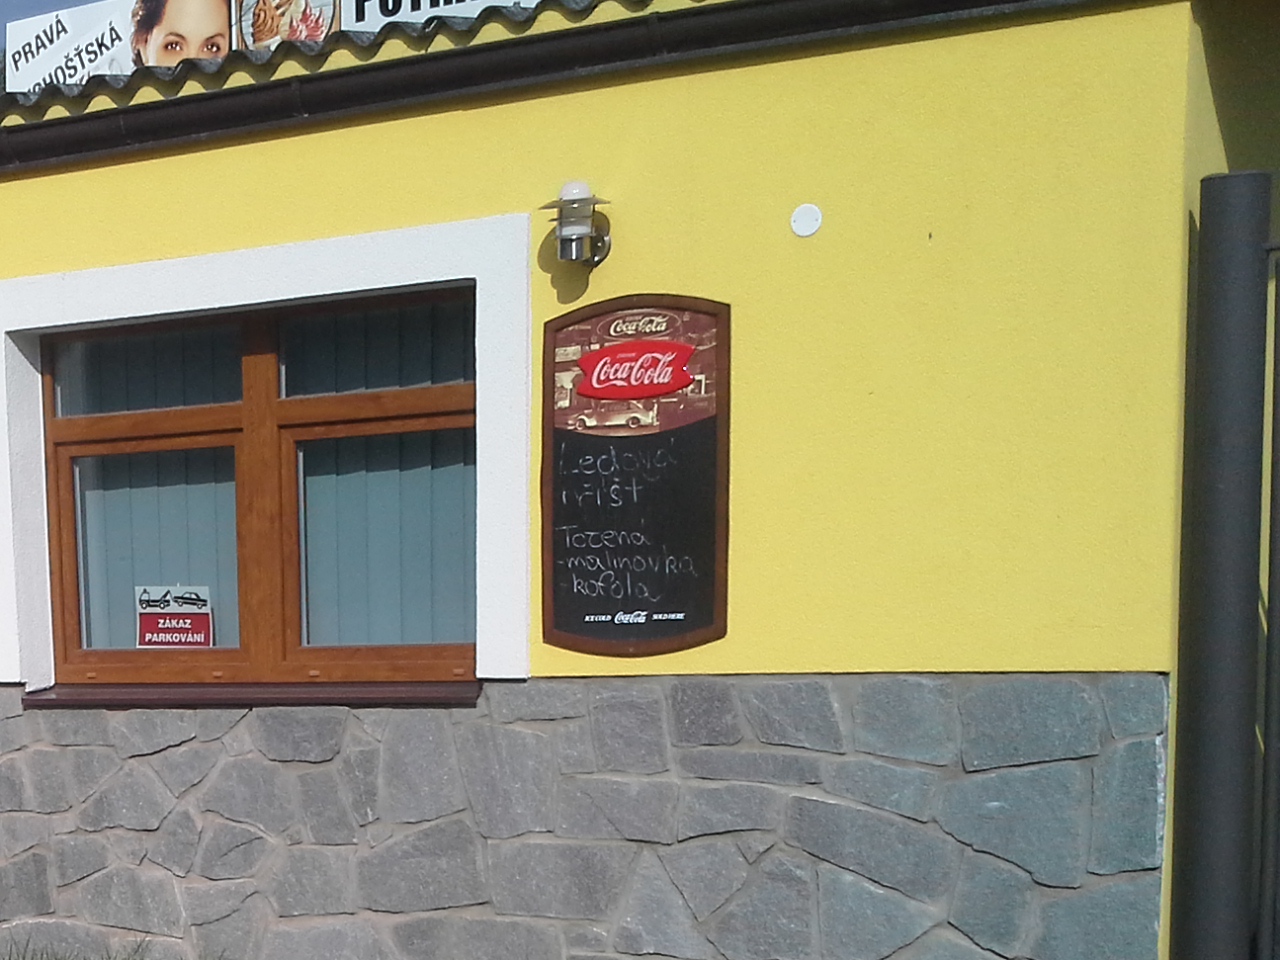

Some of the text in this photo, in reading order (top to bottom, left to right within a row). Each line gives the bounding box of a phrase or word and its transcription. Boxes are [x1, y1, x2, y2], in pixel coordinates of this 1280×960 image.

[11, 13, 69, 72] PRAVÁ
[27, 20, 123, 93] HOŠŤSKÁ
[609, 315, 669, 336] Coca-Cola
[591, 352, 677, 389] Coca-Cola
[145, 630, 205, 643] PARKOVÁNÍ
[157, 616, 192, 629] ZÁKAZ
